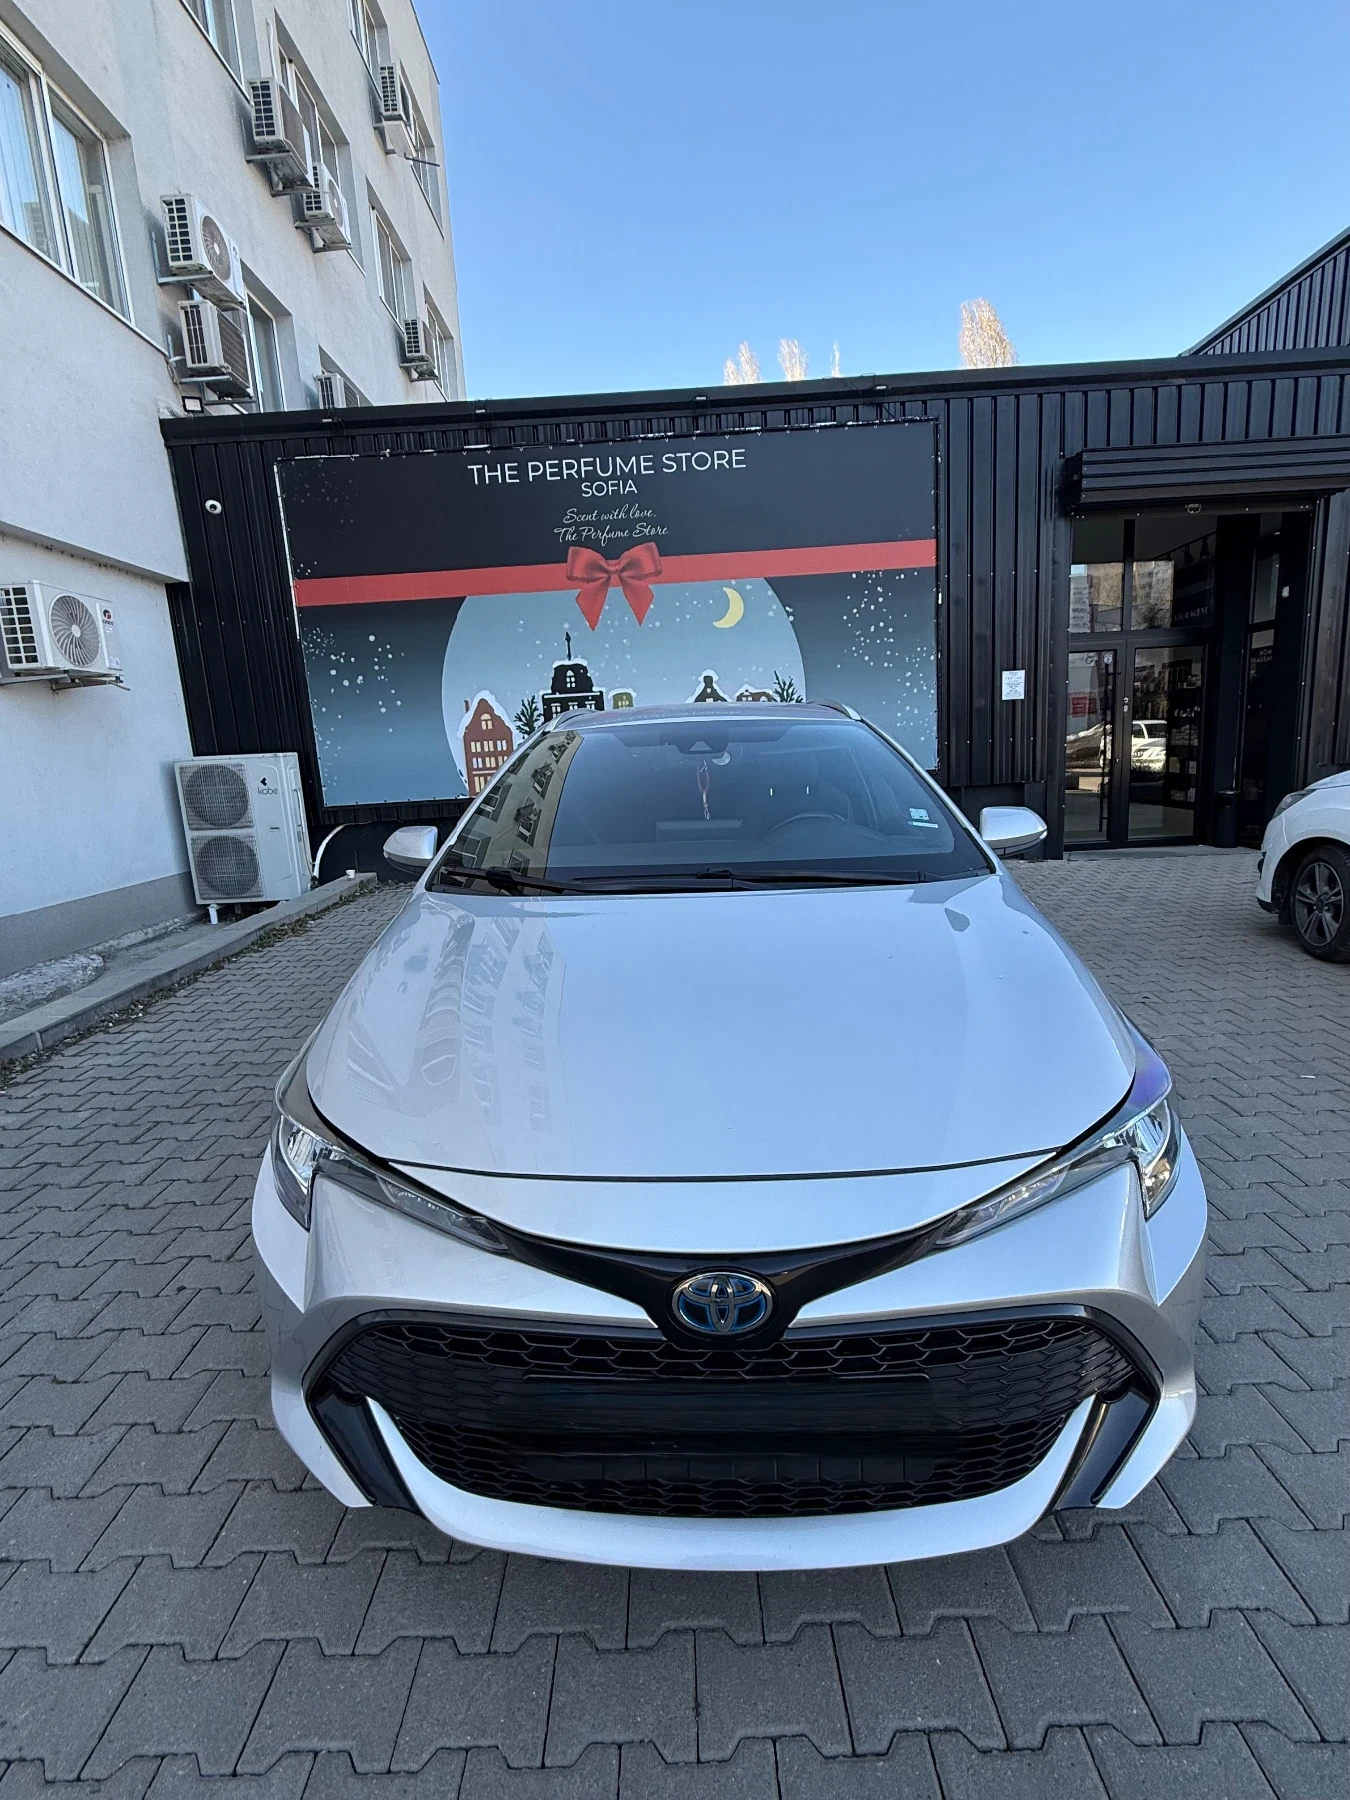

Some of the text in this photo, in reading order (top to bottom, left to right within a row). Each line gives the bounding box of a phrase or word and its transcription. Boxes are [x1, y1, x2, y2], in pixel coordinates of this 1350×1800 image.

[468, 448, 747, 485] THE PERFUME STORE
[581, 480, 638, 497] SOFIA
[563, 504, 657, 524] Scent with love.
[554, 523, 668, 546] The Perfume Store
[257, 787, 278, 795] kobe
